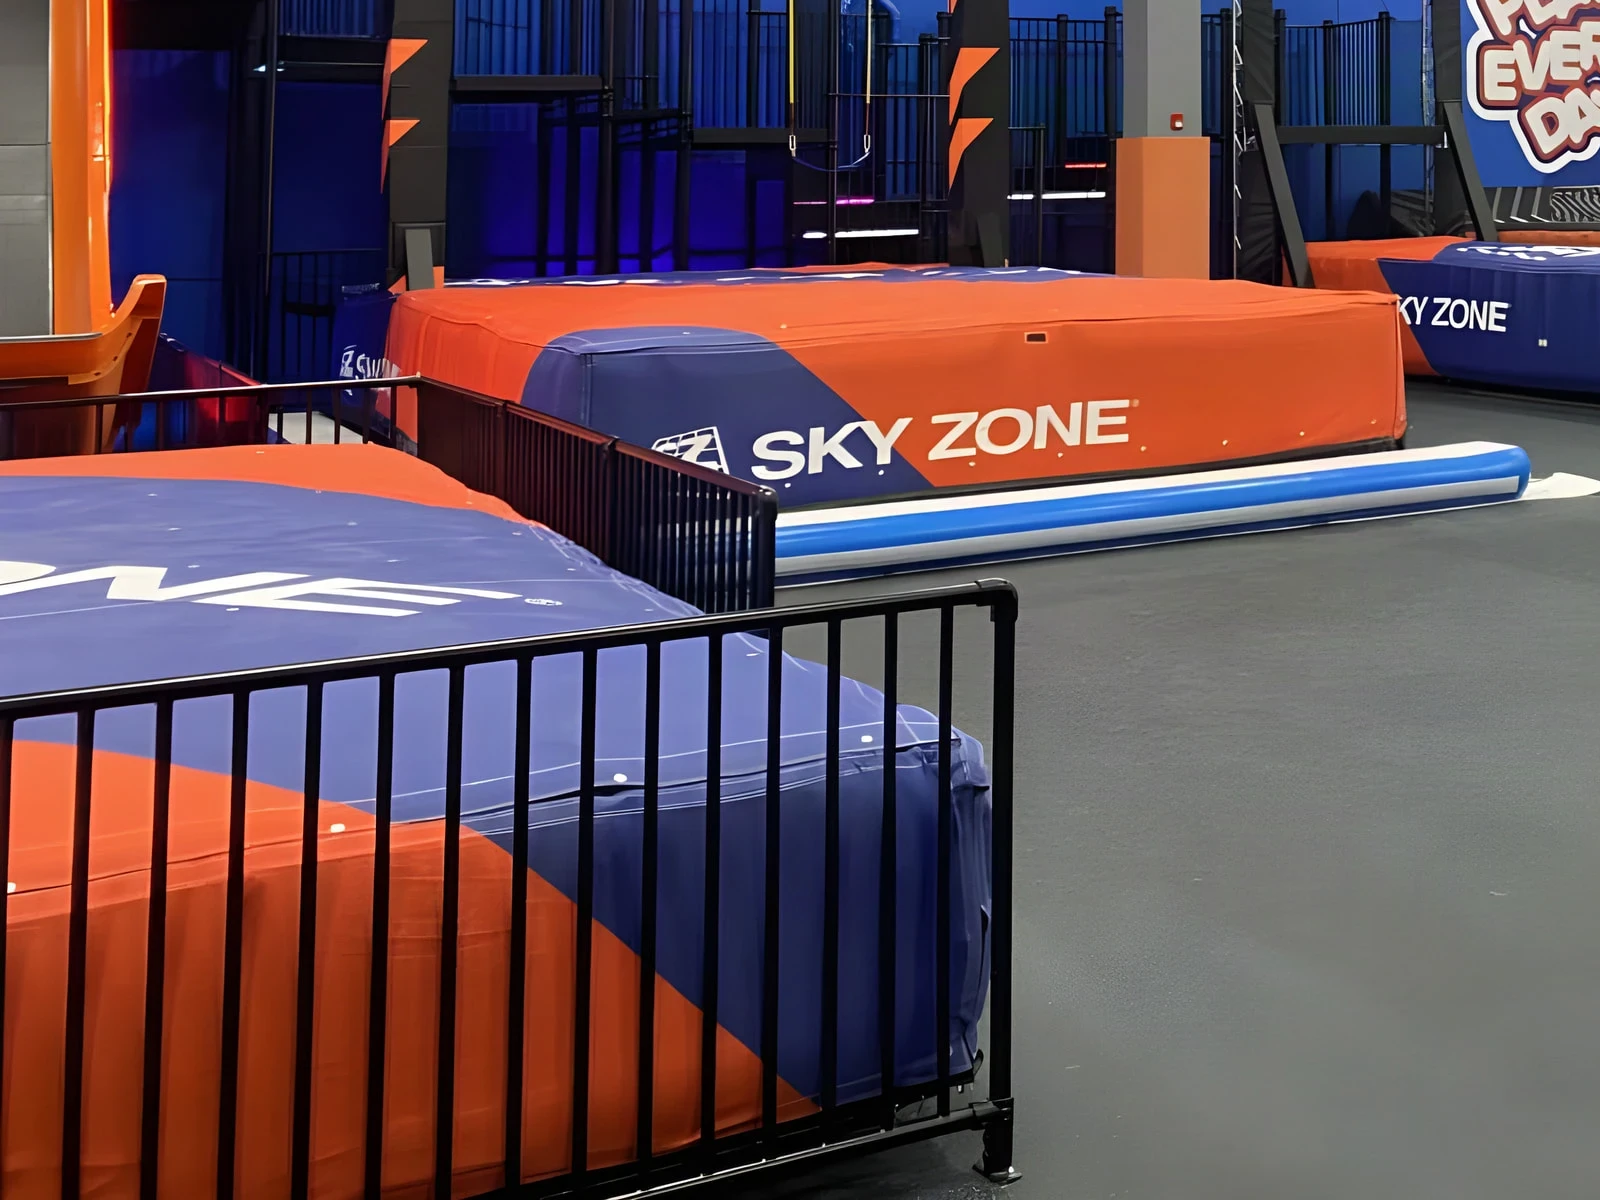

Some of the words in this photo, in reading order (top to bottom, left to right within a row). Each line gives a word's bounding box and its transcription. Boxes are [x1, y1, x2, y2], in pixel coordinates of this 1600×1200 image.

[1431, 297, 1509, 332] ZONE
[751, 418, 913, 480] SKY
[928, 399, 1130, 461] ZONE
[0, 560, 523, 617] NE
